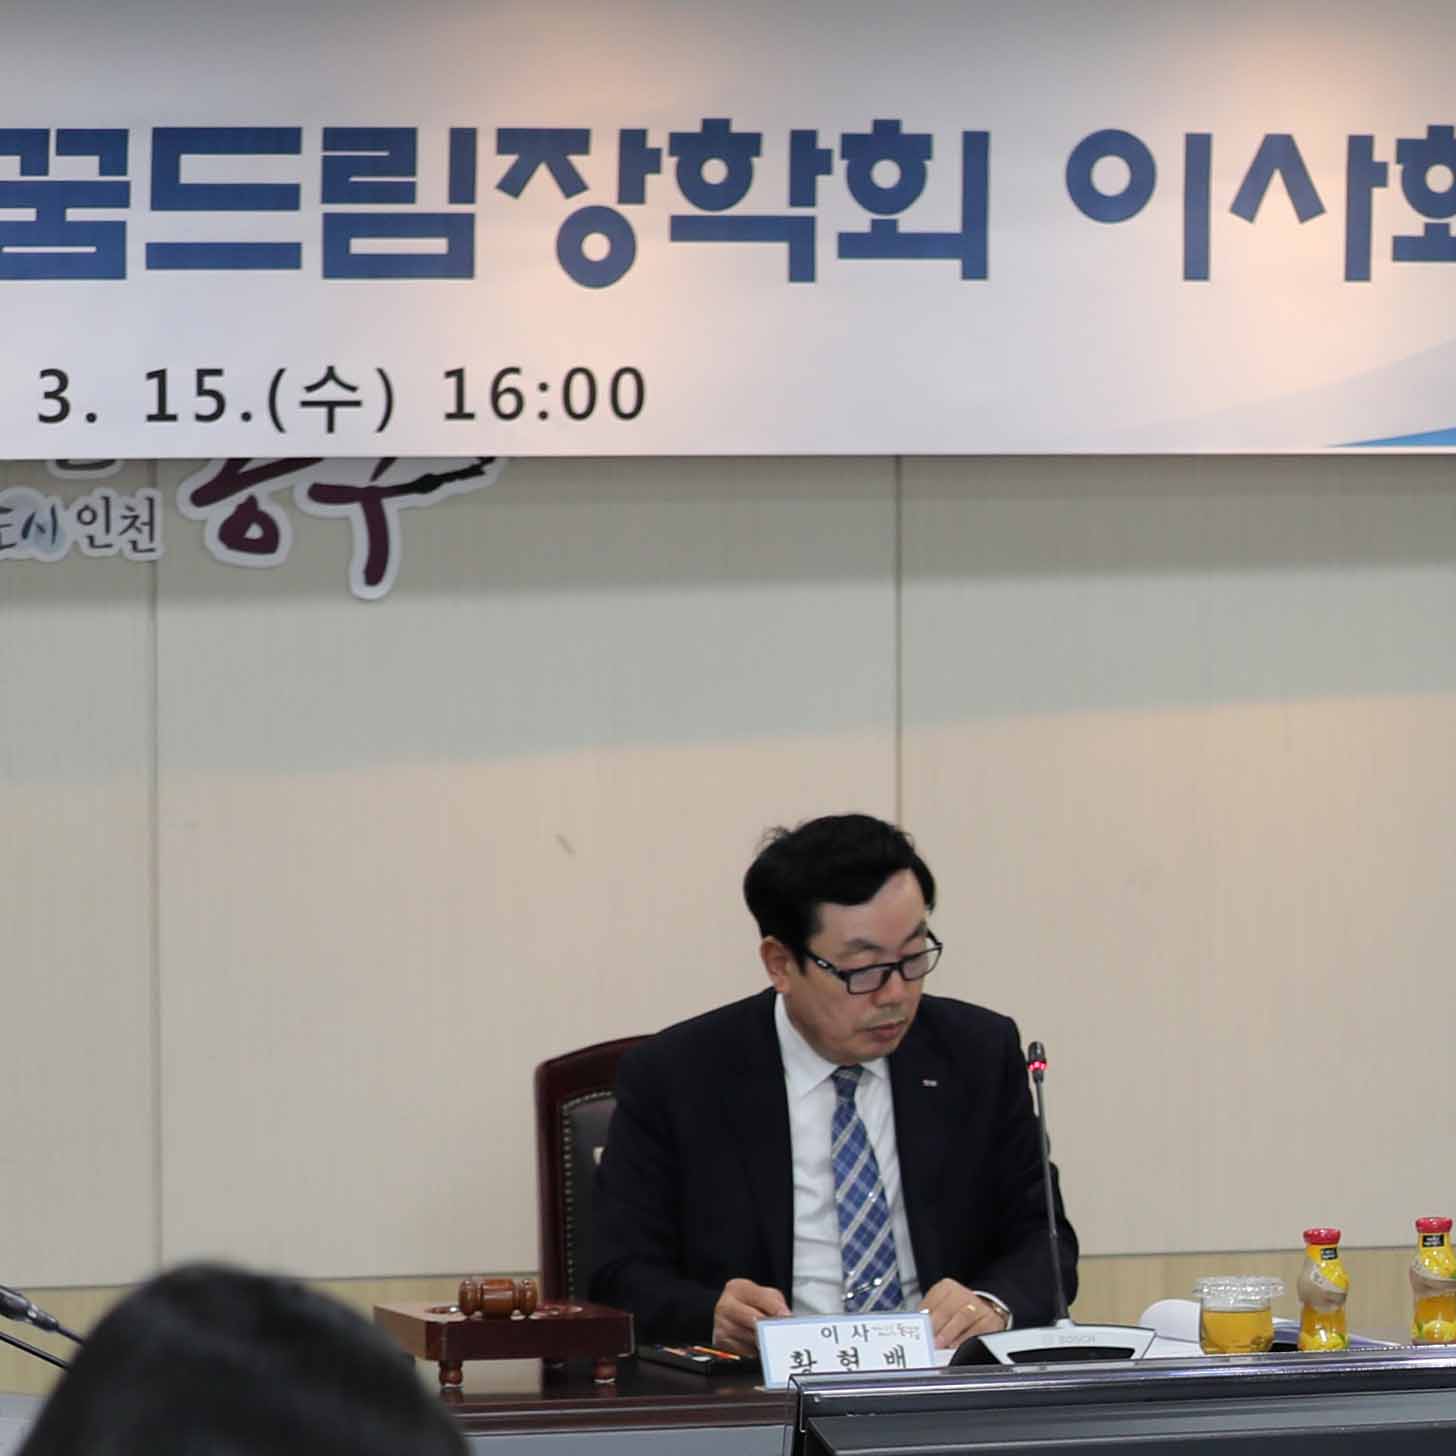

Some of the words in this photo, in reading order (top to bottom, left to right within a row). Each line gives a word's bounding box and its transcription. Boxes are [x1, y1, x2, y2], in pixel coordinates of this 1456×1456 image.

[36, 370, 98, 424] 3.
[145, 366, 396, 434] 15.(수)
[443, 367, 647, 422] 16:00
[76, 495, 158, 553] 인천
